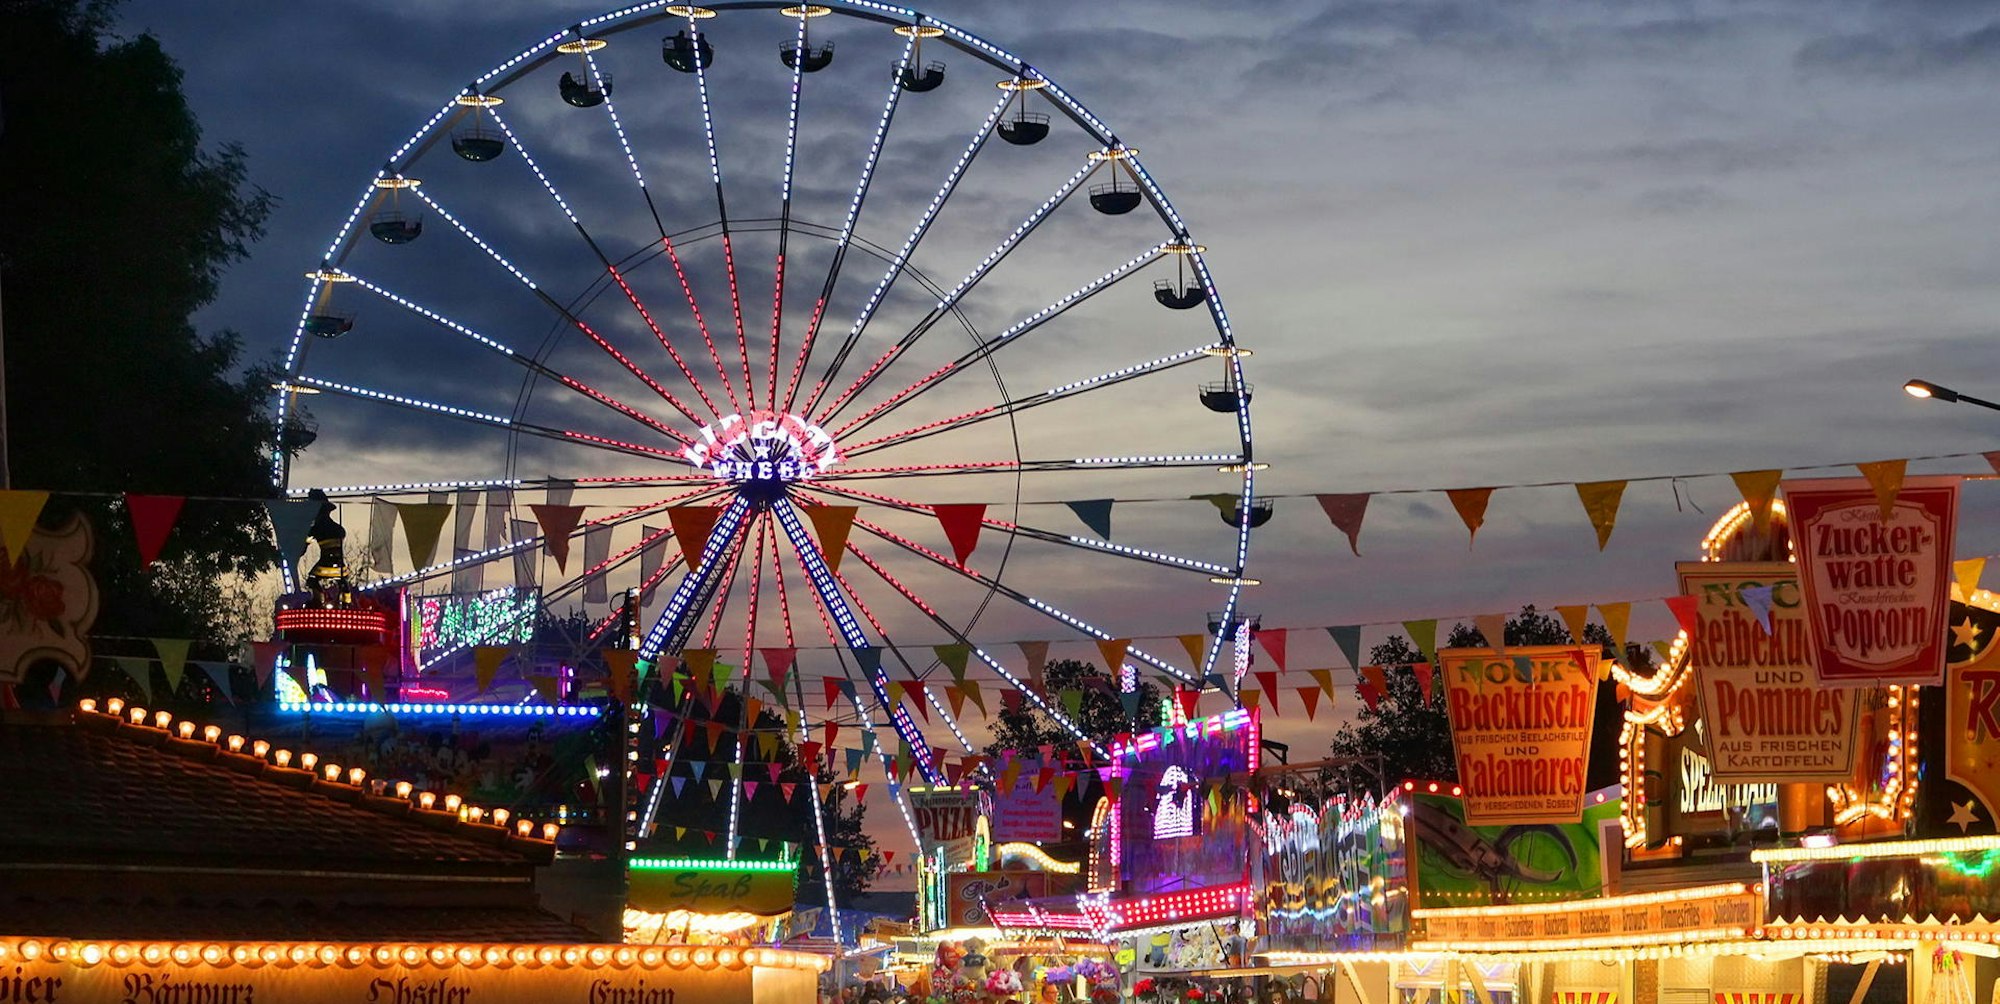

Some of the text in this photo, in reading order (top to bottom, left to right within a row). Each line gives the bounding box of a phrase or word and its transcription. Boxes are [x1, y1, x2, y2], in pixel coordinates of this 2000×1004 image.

[711, 460, 814, 480] WHEEL
[1817, 522, 1932, 557] Zucker-
[1825, 554, 1916, 590] watte
[1822, 602, 1927, 658] Popcorn
[1755, 672, 1804, 684] UND
[1452, 684, 1588, 732] Backfisch
[1714, 679, 1843, 736] Pommes
[1504, 746, 1539, 756] UND
[1719, 739, 1842, 752] AUS FRISCHEN
[1728, 755, 1834, 767] KARTOFFELN
[1460, 754, 1583, 798] Calamares
[915, 806, 974, 841] PIZZA
[670, 872, 753, 903] Spaß
[123, 973, 255, 1004] Bärwurz
[367, 977, 472, 1004] Obstler
